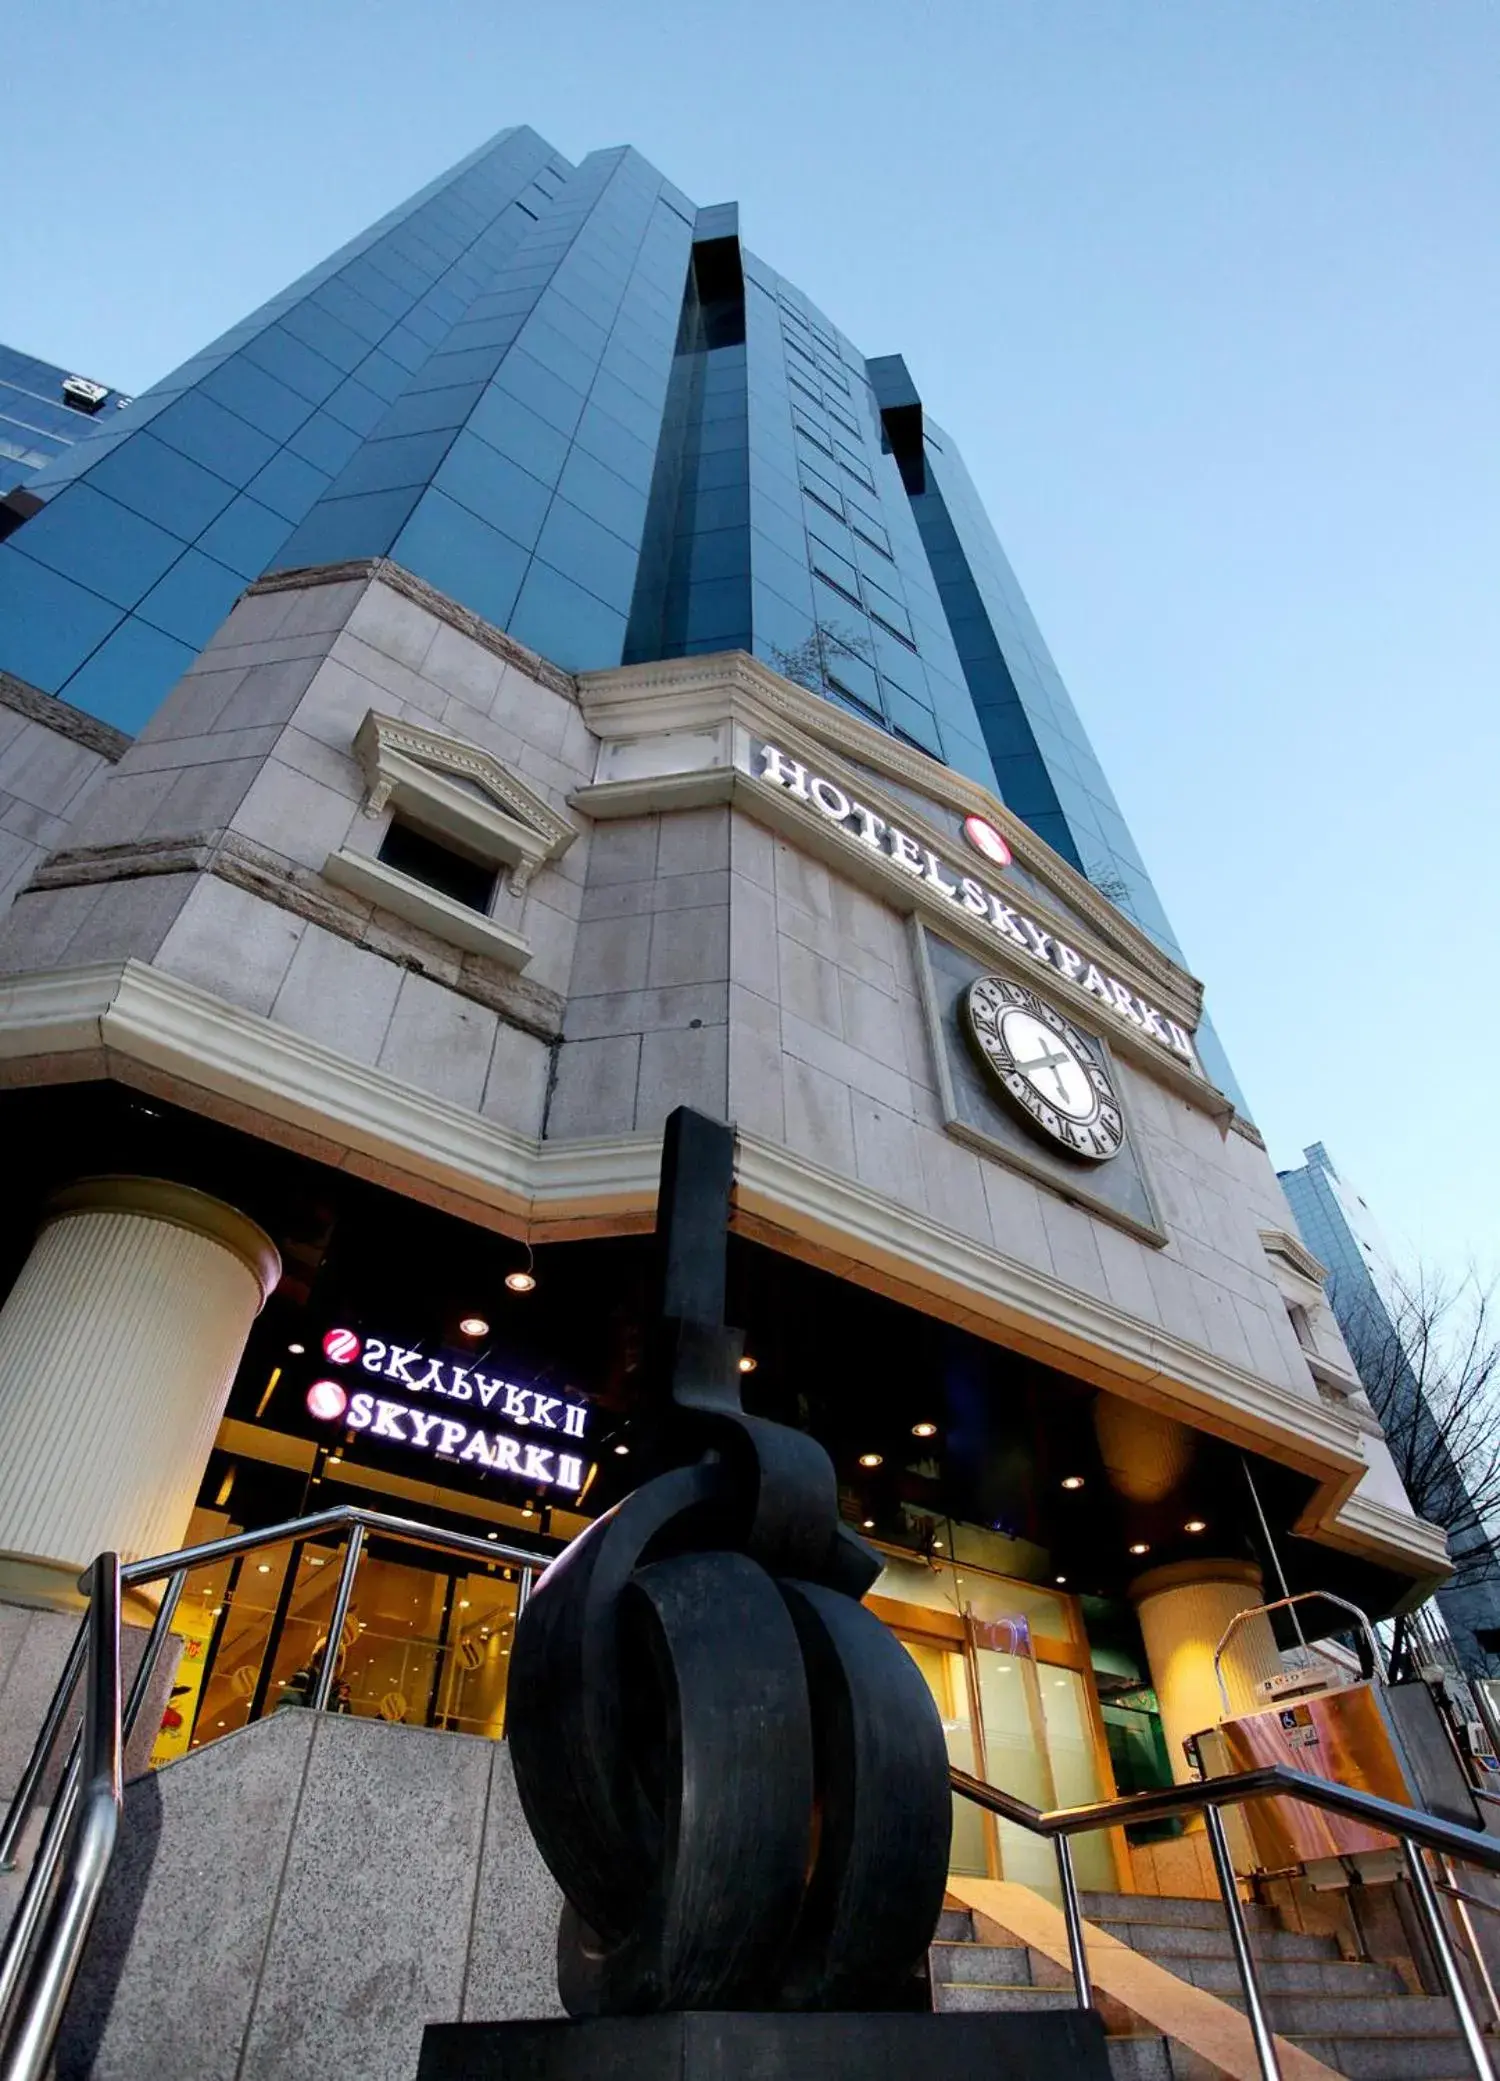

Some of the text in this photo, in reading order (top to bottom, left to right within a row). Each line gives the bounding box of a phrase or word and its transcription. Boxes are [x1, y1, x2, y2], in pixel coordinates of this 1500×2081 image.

[760, 745, 956, 897] HOTEL
[963, 877, 1169, 1042] SKYPARK
[346, 1393, 555, 1483] SKYPARK
